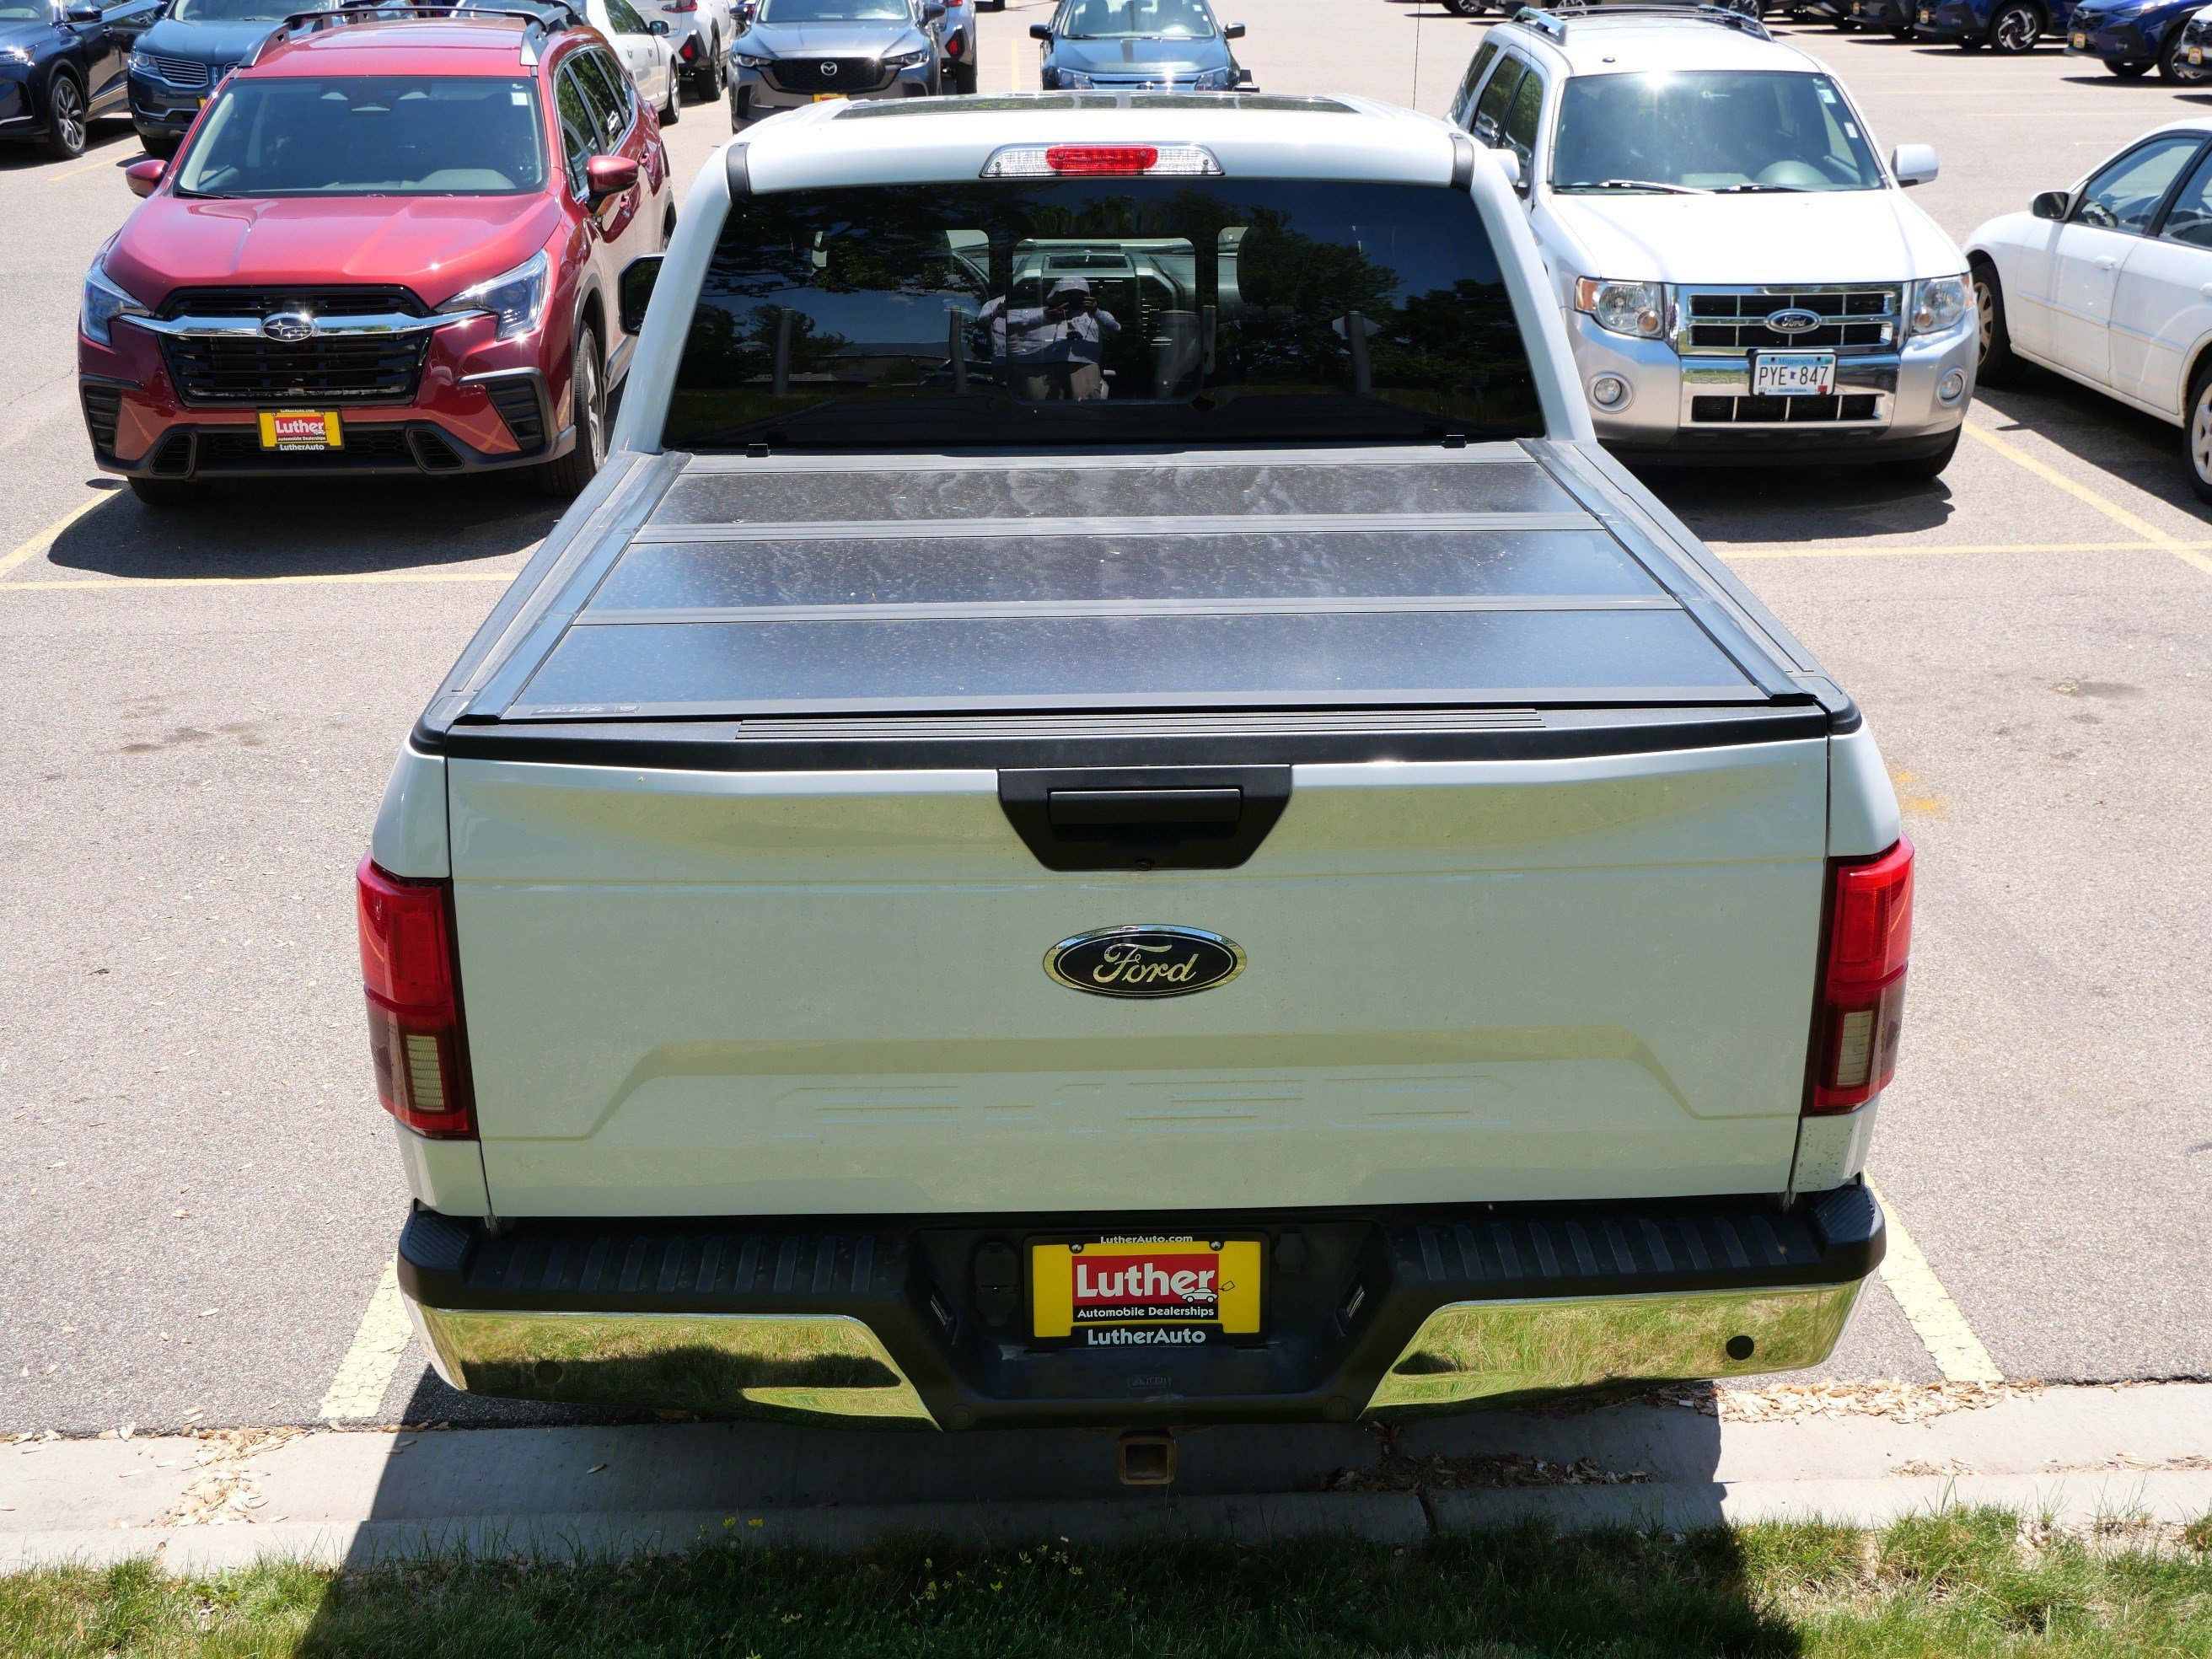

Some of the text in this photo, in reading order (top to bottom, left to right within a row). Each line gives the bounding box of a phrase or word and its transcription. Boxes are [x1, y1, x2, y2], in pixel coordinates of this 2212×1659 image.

[1781, 315, 1807, 327] Ford
[1758, 366, 1829, 386] PYE 847
[275, 419, 325, 434] Luther
[1093, 943, 1200, 984] Ford
[1100, 1235, 1194, 1244] LutherAuto.com
[1076, 1262, 1216, 1298] Luther
[1076, 1306, 1215, 1318] Automobile Dealerships
[1087, 1328, 1206, 1345] LutherAuto
